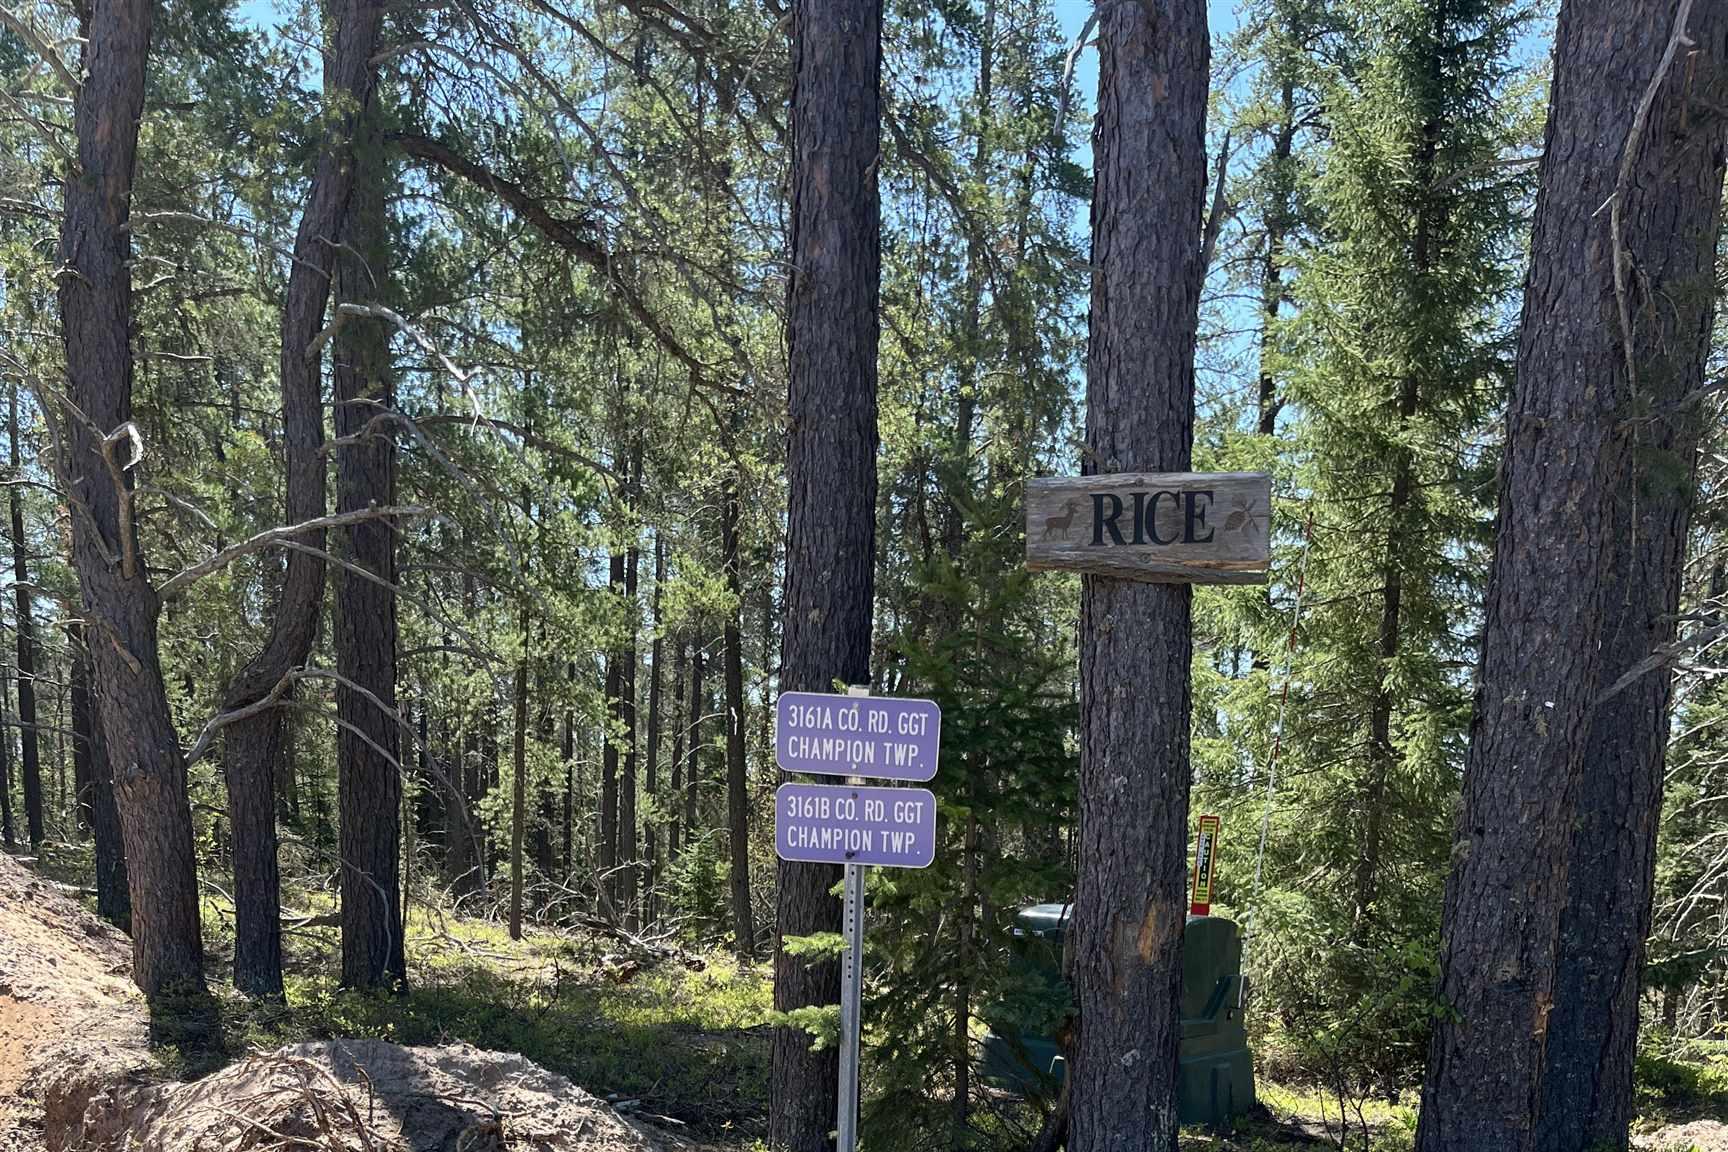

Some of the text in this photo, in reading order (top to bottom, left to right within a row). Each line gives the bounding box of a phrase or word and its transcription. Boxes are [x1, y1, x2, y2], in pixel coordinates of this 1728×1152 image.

[1088, 490, 1215, 546] RICE
[788, 705, 928, 736] 3161A CO. RD. GGT
[788, 736, 924, 768] CHAMPION TWP.
[787, 796, 923, 824] 3161B CO. RD. GGT
[787, 826, 920, 855] CHAMPION TWP.
[1200, 833, 1211, 887] CAUTION
